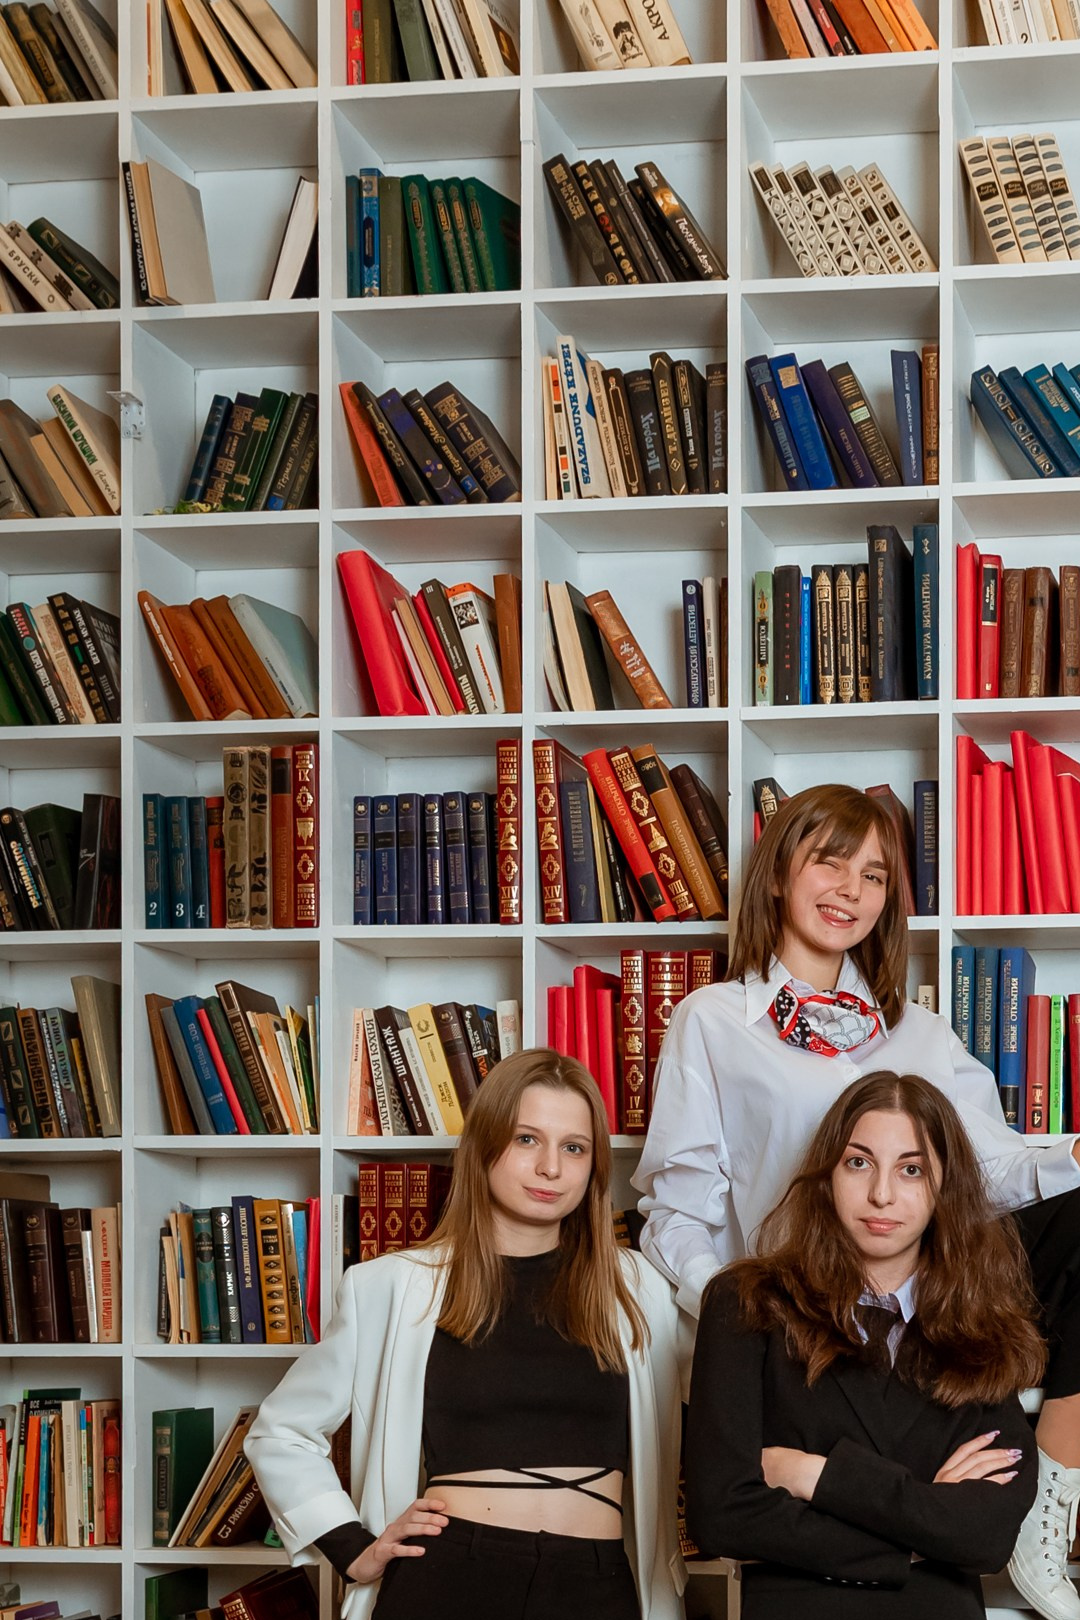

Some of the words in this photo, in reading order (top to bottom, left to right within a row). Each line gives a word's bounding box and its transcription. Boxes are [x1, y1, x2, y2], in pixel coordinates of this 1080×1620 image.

[567, 198, 580, 222] МОРЕ
[573, 193, 587, 218] СУШЕ
[8, 250, 39, 288] БРУСКИ
[560, 343, 577, 390] KÉPEI
[52, 393, 77, 435] ВАСИЛИЙ
[72, 431, 98, 467] ШУКШИН
[415, 403, 447, 444] Мелвилл
[639, 410, 655, 446] горах
[658, 378, 679, 456] Т.ДРАЙЗЕР
[713, 408, 727, 449] горах
[438, 440, 467, 475] Герман
[602, 422, 615, 466] Комплекты
[920, 573, 931, 627] ВИЗАНТИИ
[70, 606, 90, 638] МУЗЫКЕ
[687, 604, 697, 643] ДЕТЕКТИВ
[81, 636, 101, 665] ВЕРЬТЕ
[922, 631, 933, 678] КУЛЬТУРА
[689, 644, 700, 703] ФРАНЦУЗСКИЙ
[601, 774, 628, 817] ОТКРЫТИЯ
[621, 816, 640, 843] НОВЫЕ
[11, 840, 41, 910] РЕАНИМАТОР
[670, 818, 694, 867] ПАМЯТНИКИ
[689, 866, 710, 908] КУЛЬТУРЫ
[500, 885, 519, 900] XIV
[543, 884, 562, 899] XIV
[668, 879, 688, 896] VIII
[148, 901, 158, 916] 2
[176, 902, 185, 918] 3
[195, 903, 206, 919] 4
[961, 975, 970, 1020] ОТКРЫТИЯ
[977, 957, 986, 999] КУЛЬТУРЫ
[1002, 958, 1011, 999] КУЛЬТУРЫ
[984, 975, 992, 1021] ОТКРЫТИЯ
[1010, 976, 1018, 1021] ОТКРЫТИЯ
[186, 1021, 200, 1042] ЗОВ
[364, 1017, 380, 1058] КУХНЯ
[977, 1001, 985, 1052] ПАМЯТНИКИ
[984, 1024, 992, 1053] НОВЫЕ
[1003, 1001, 1011, 1052] ПАМЯТНИКИ
[1010, 1023, 1018, 1053] НОВЫЕ
[19, 1013, 55, 1121] СТЕНДАЛЬ
[194, 1041, 212, 1080] ВЕЧНЫЙ
[381, 1024, 408, 1077] ШАНТАЖ
[370, 1057, 390, 1131] ЛАТЫШСКАЯ
[1033, 1113, 1042, 1127] 4
[101, 1259, 110, 1294] МОЛОДАЯ
[226, 1270, 235, 1295] ХАРМС
[102, 1295, 112, 1330] ГВАРДИЯ
[29, 1399, 40, 1409] ВСЕ
